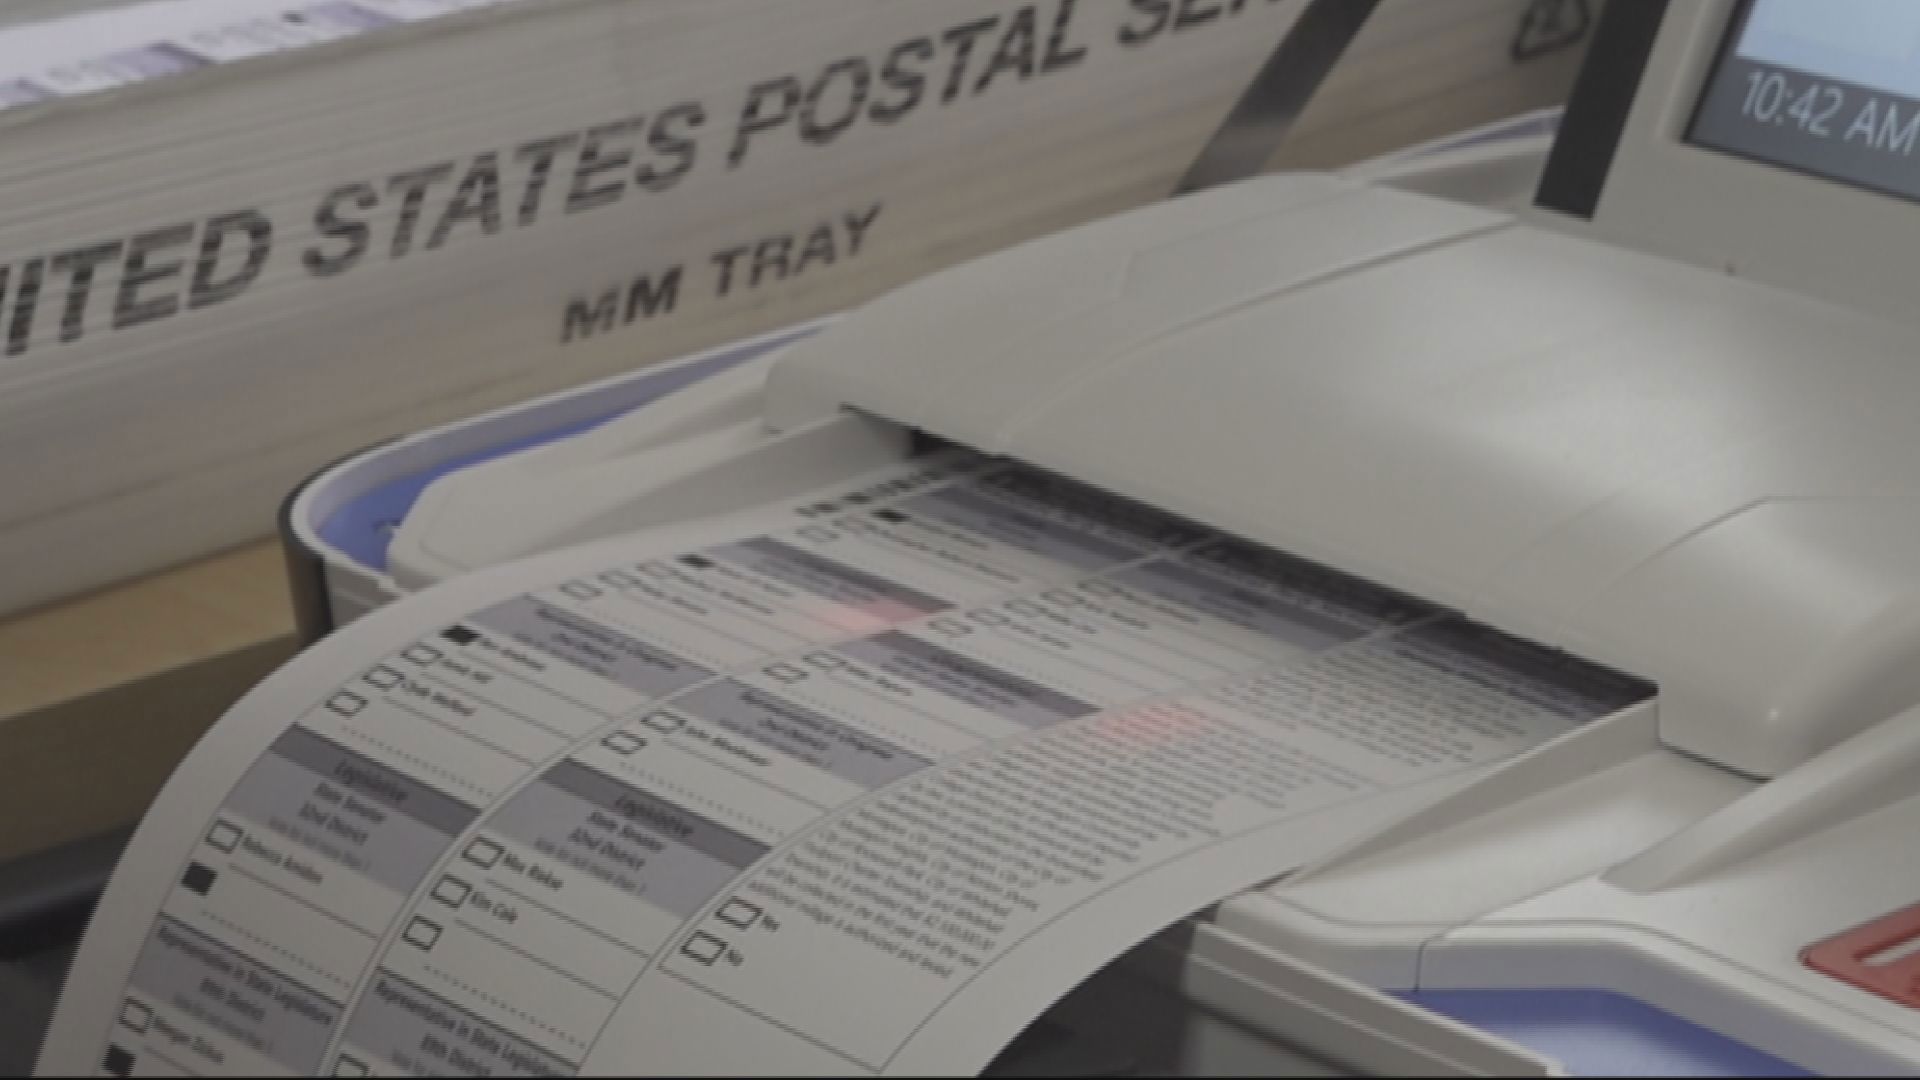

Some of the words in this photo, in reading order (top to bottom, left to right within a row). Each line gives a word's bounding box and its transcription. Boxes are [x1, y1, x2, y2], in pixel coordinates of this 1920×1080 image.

[1743, 71, 1844, 137] 10:42
[1844, 98, 1920, 156] AM
[0, 207, 272, 357] ITED
[303, 101, 704, 278] STATES
[726, 0, 1088, 170] POSTAL
[560, 265, 683, 345] MM
[711, 202, 882, 299] TRAY
[315, 782, 343, 803] State
[344, 796, 387, 824] Senator
[334, 760, 410, 805] Legislative
[327, 815, 369, 844] District
[587, 812, 618, 831] State
[619, 826, 667, 852] Senator
[613, 796, 696, 838] Legislative
[599, 842, 647, 869] District
